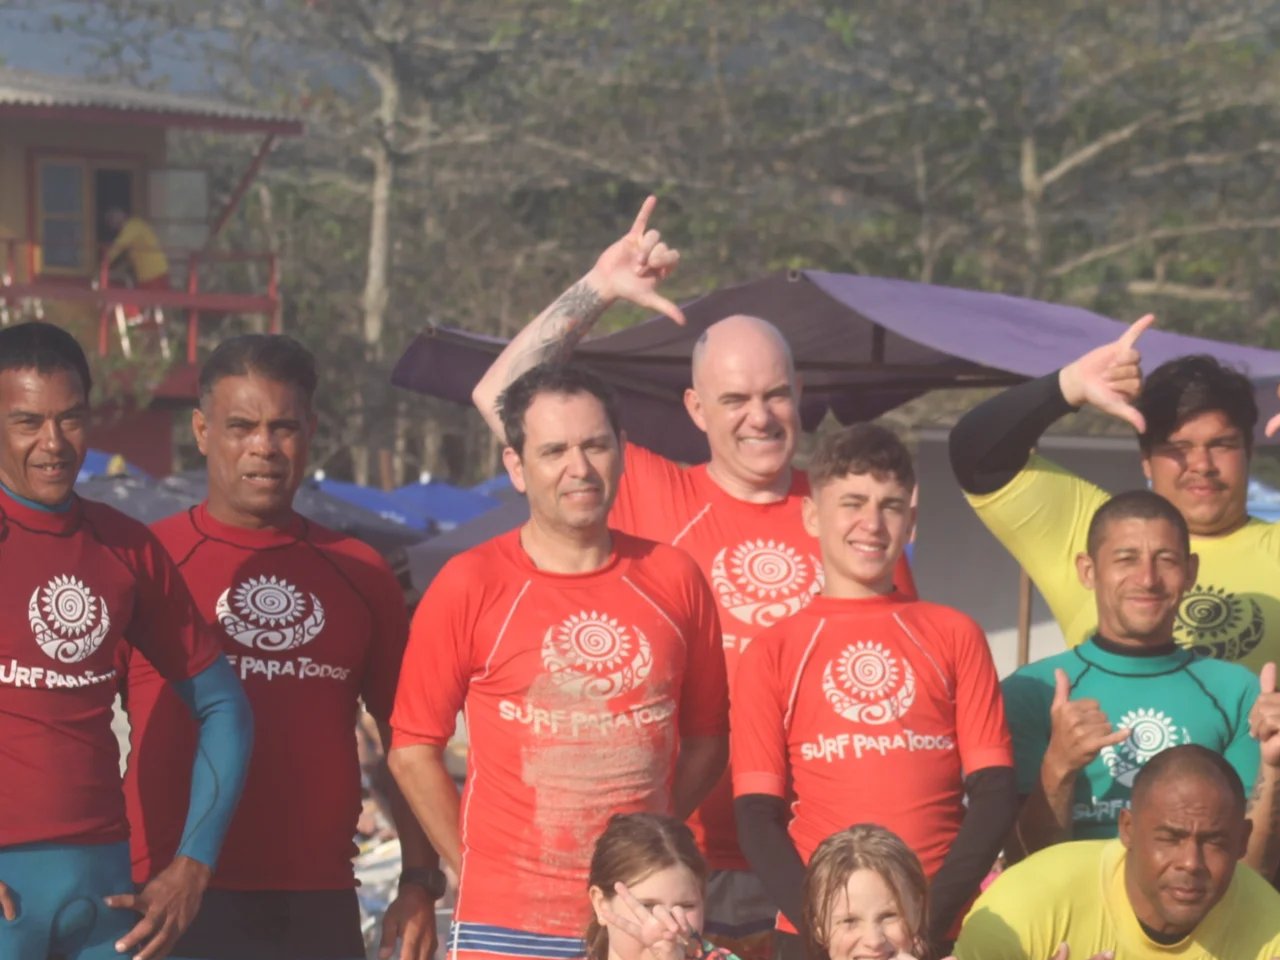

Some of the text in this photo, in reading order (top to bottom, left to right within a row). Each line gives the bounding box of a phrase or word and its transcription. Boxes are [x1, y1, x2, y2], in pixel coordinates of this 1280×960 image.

[0, 659, 44, 688] URF
[241, 656, 295, 681] PARA
[499, 699, 566, 735] SURF
[570, 710, 631, 737] PARA
[801, 734, 849, 763] SURF
[852, 733, 907, 759] PARA
